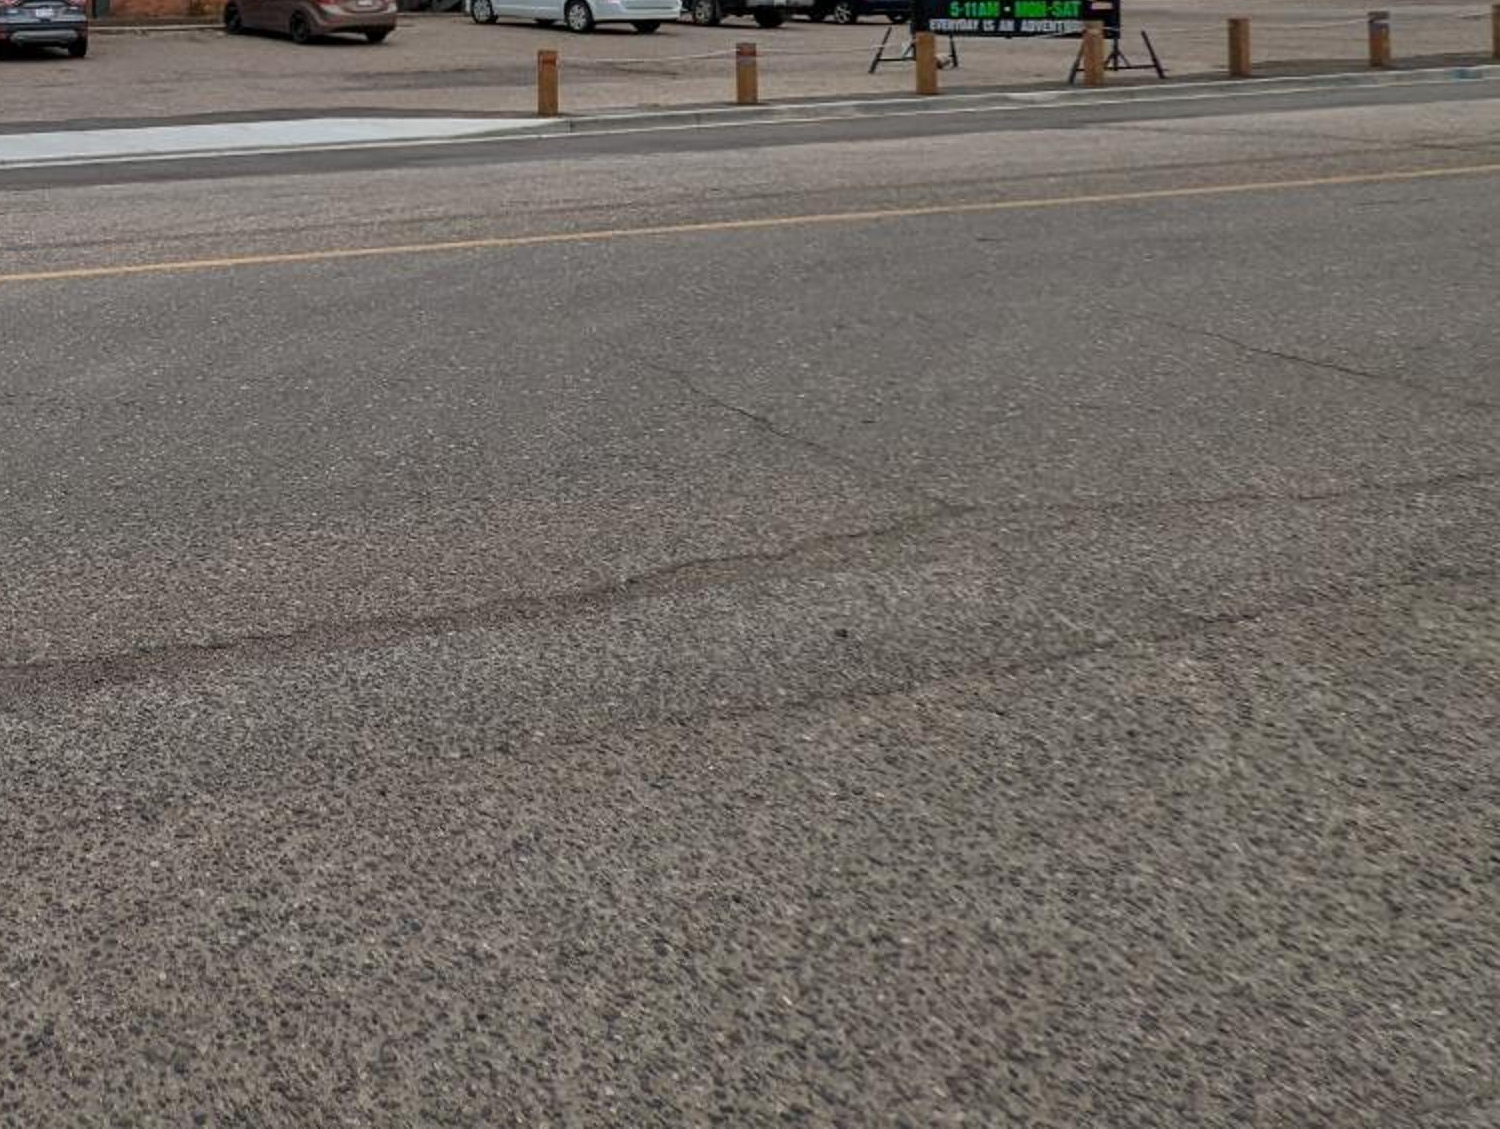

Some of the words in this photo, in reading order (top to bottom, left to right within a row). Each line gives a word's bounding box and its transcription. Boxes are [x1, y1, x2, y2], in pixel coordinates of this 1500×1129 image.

[929, 18, 979, 31] EVERYDAY
[983, 19, 996, 31] IS
[998, 19, 1015, 31] AN
